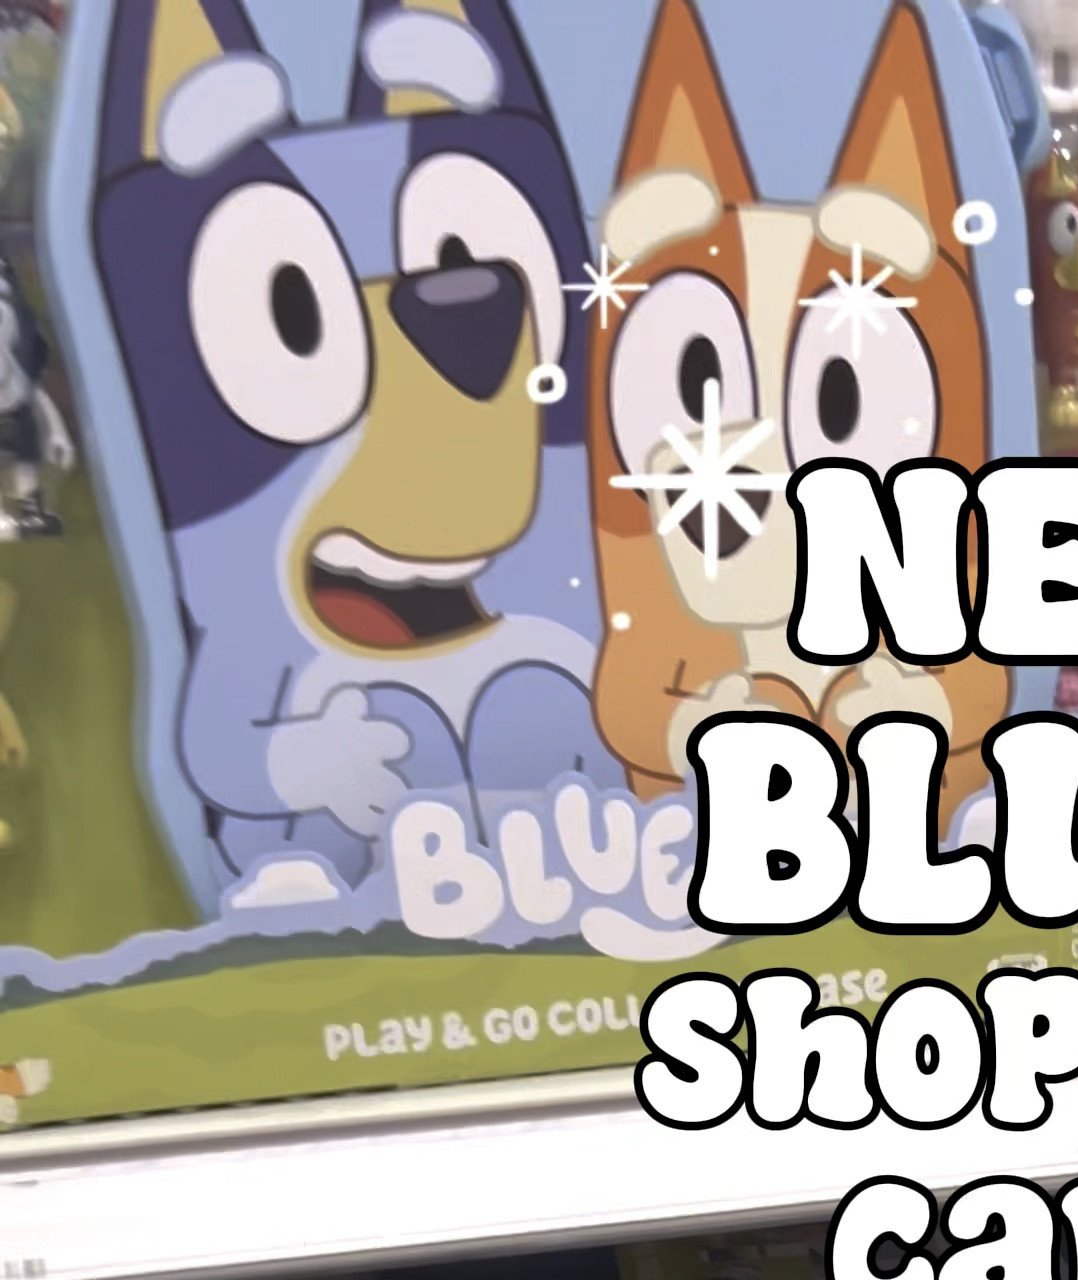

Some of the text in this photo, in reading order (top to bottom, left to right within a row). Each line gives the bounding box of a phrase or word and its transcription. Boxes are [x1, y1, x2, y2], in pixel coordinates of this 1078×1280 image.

[392, 784, 735, 961] BLUE
[323, 1015, 433, 1061] PLAY
[442, 1013, 478, 1050] &
[484, 1004, 539, 1044] GO
[820, 967, 888, 1009] ase
